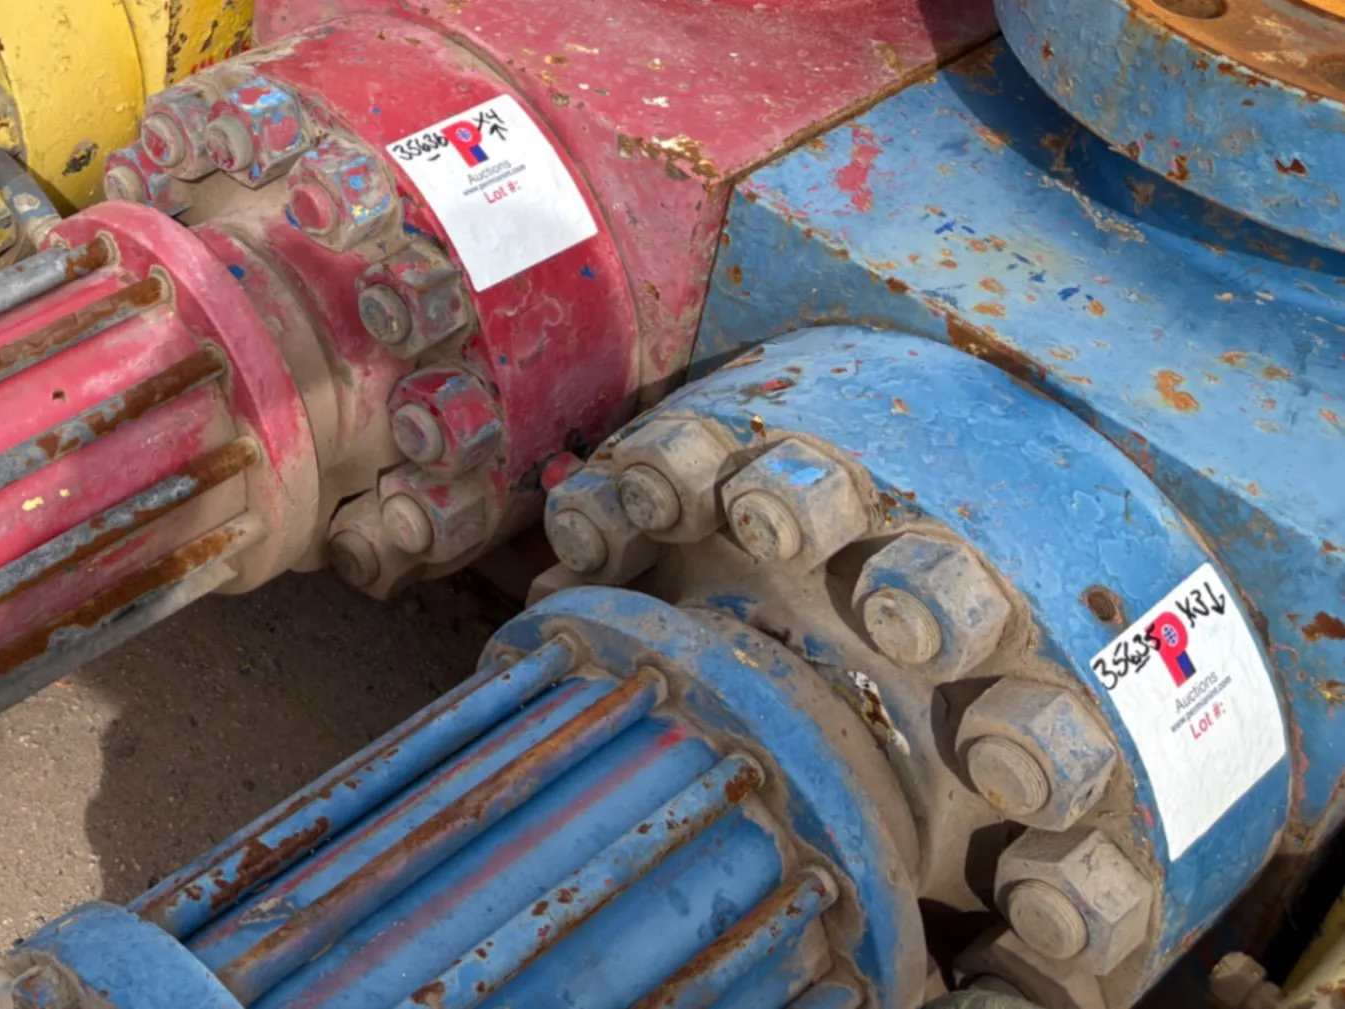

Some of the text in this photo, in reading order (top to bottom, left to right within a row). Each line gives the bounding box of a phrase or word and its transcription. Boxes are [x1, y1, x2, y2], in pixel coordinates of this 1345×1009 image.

[393, 131, 450, 161] 35636
[467, 159, 512, 184] Auctions
[483, 185, 509, 204] Lot
[1093, 623, 1162, 690] 35635
[1175, 670, 1219, 714] Auctions
[1189, 712, 1214, 740] Lot
